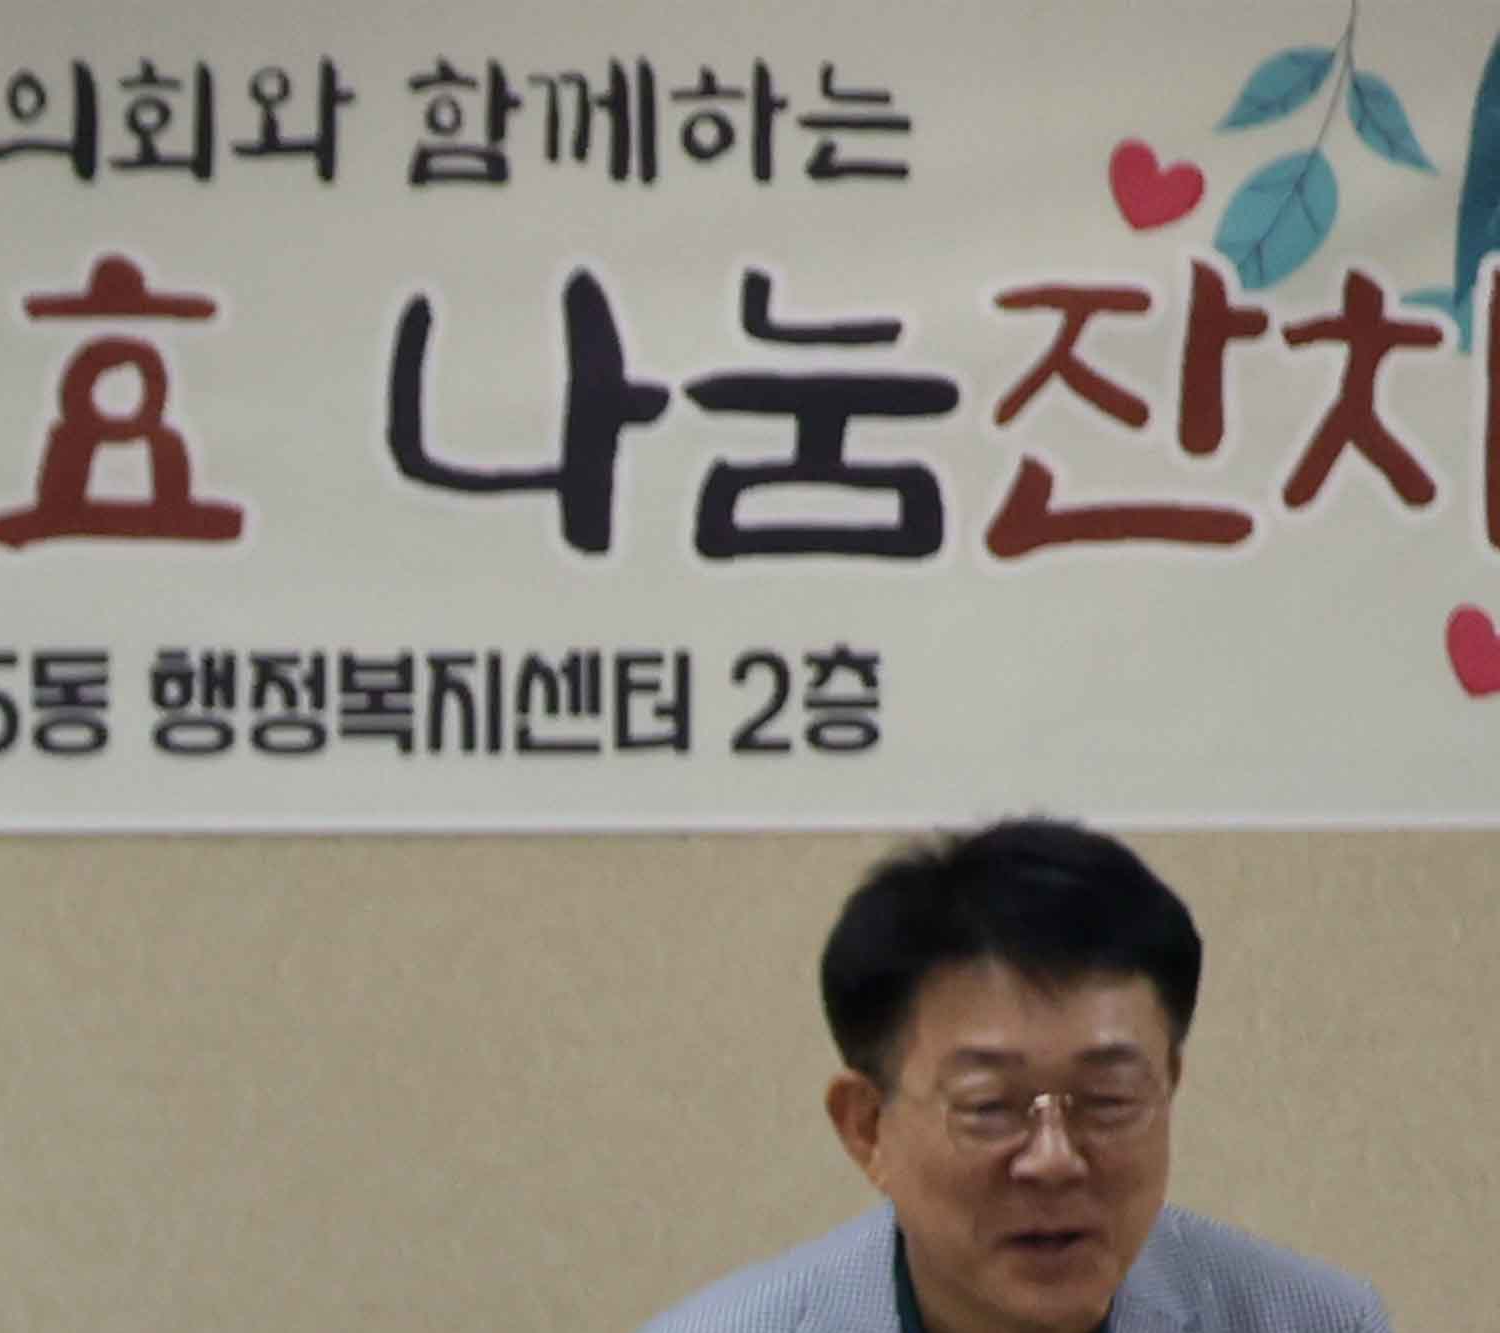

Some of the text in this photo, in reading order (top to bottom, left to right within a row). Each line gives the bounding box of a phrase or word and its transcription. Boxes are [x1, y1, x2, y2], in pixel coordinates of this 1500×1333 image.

[407, 56, 912, 187] 함께하는
[148, 647, 692, 757] 행정복지센터
[729, 644, 881, 756] 2층
